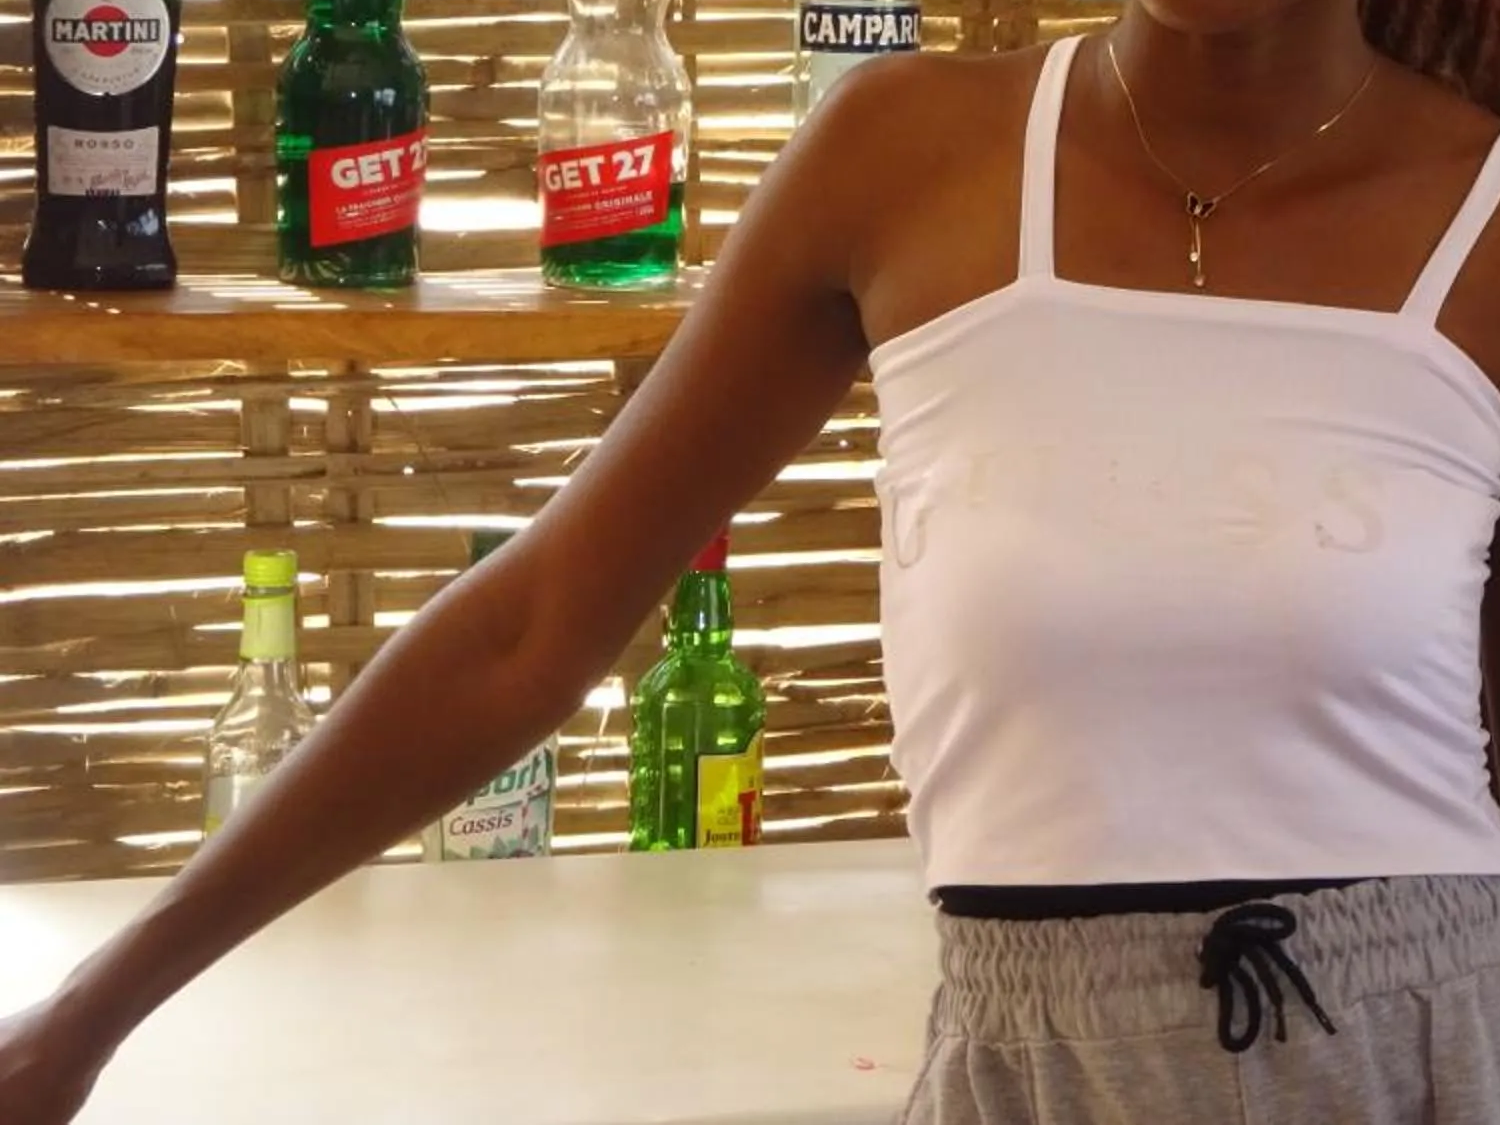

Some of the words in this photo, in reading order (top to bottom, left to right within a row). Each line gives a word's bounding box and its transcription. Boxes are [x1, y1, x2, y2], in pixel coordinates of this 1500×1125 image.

[55, 20, 158, 41] MARTINI
[803, 12, 920, 46] CAMPARI
[330, 148, 404, 190] GET
[545, 155, 605, 191] GET
[611, 144, 655, 182] 27
[449, 810, 513, 836] Cassis
